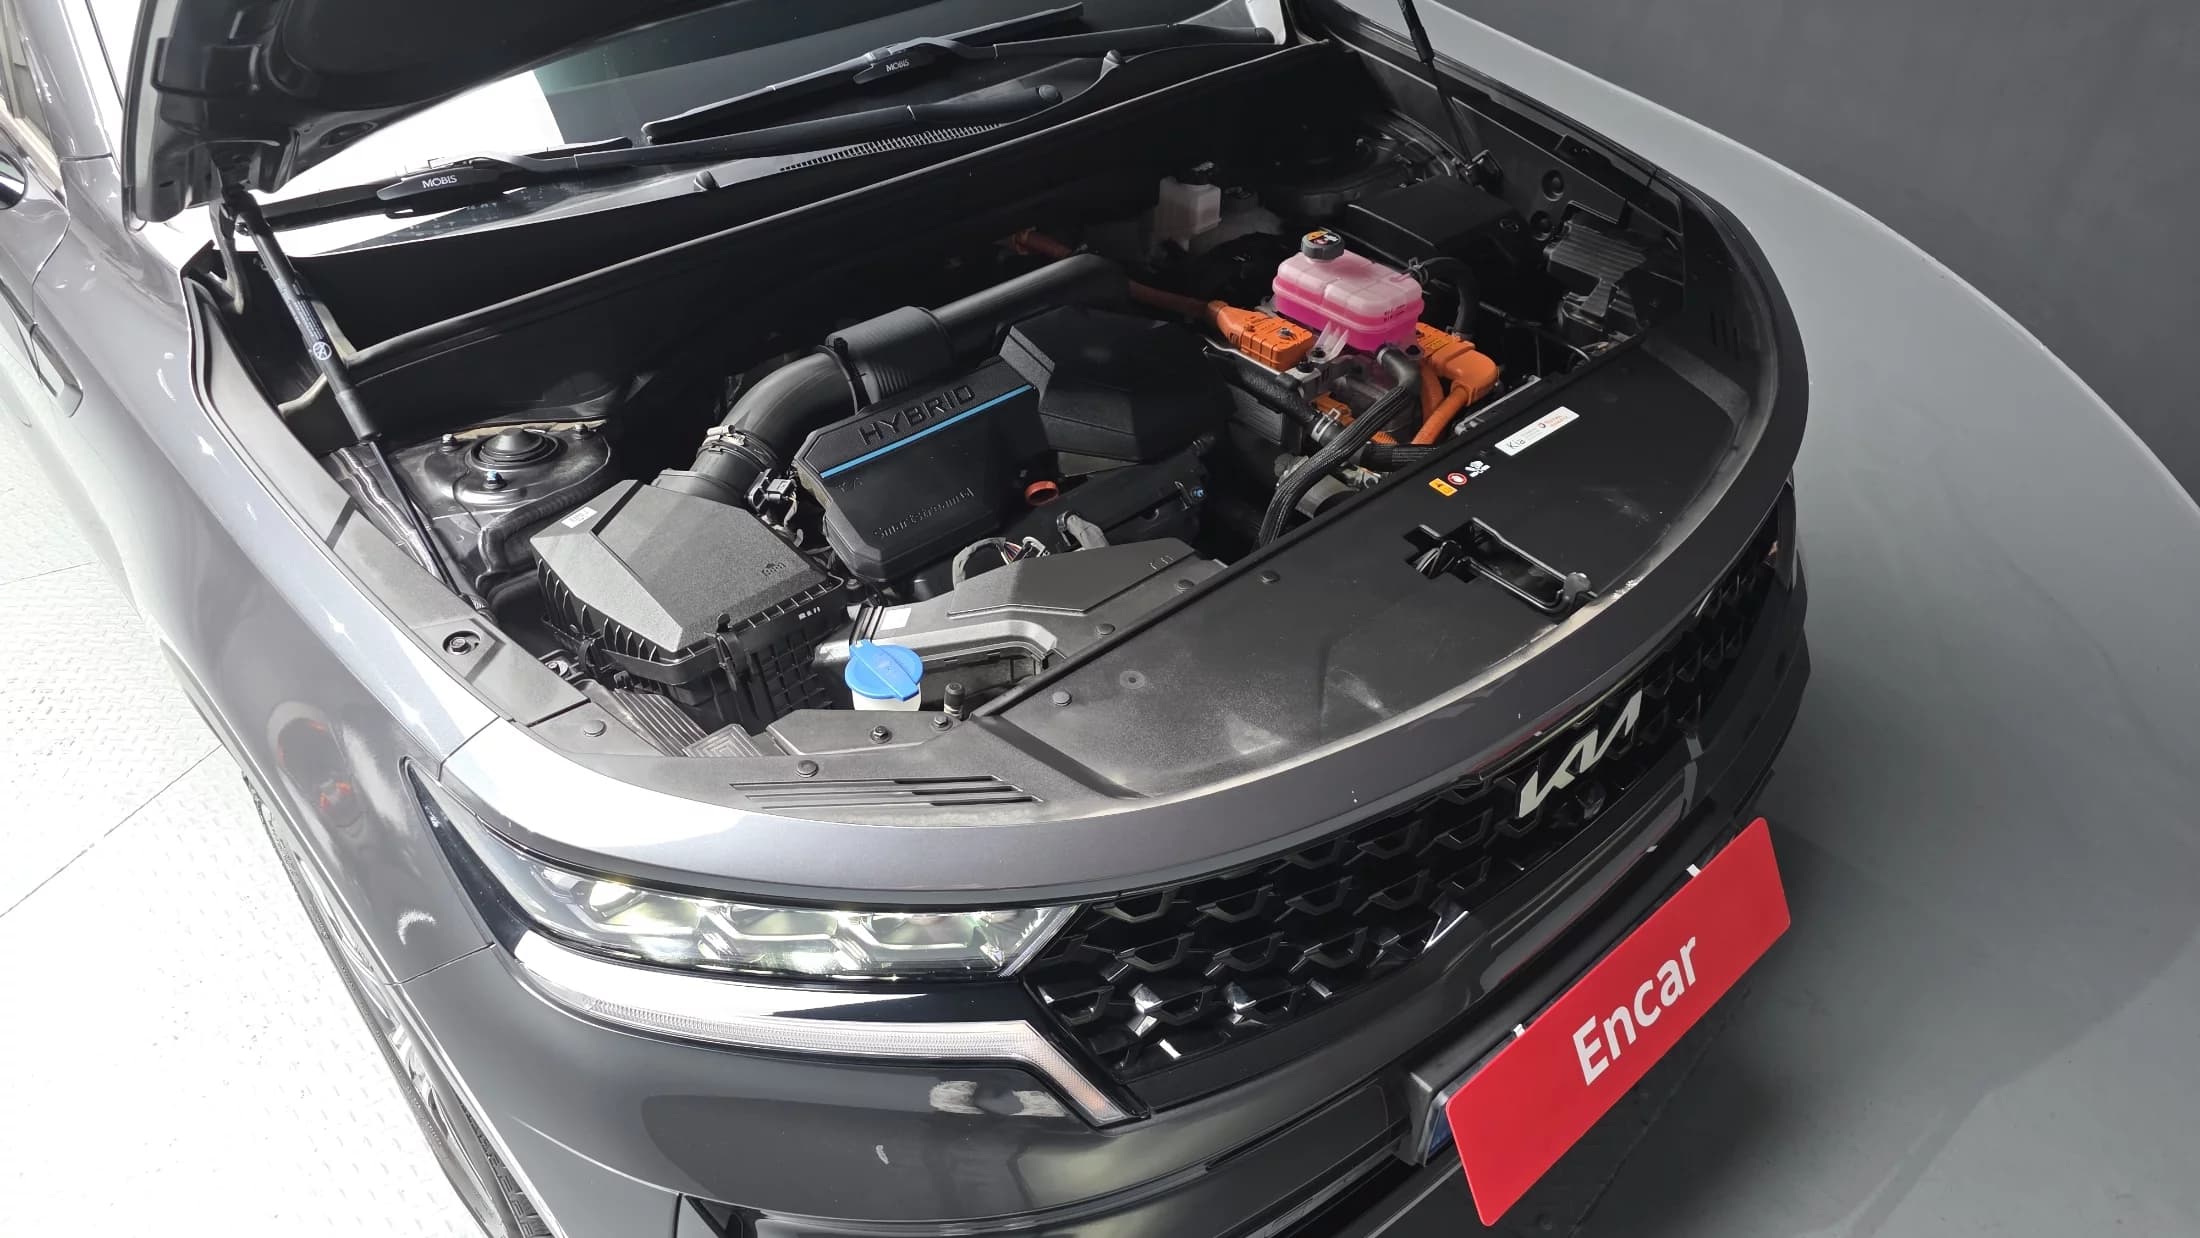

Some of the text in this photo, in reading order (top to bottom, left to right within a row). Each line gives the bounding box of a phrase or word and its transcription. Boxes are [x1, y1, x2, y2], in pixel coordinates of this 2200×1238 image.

[886, 59, 910, 72] MOBIS
[421, 174, 458, 189] MOBIS
[858, 384, 976, 446] HYBRID
[1519, 689, 1643, 818] KIA
[1572, 936, 1696, 1086] Encar
